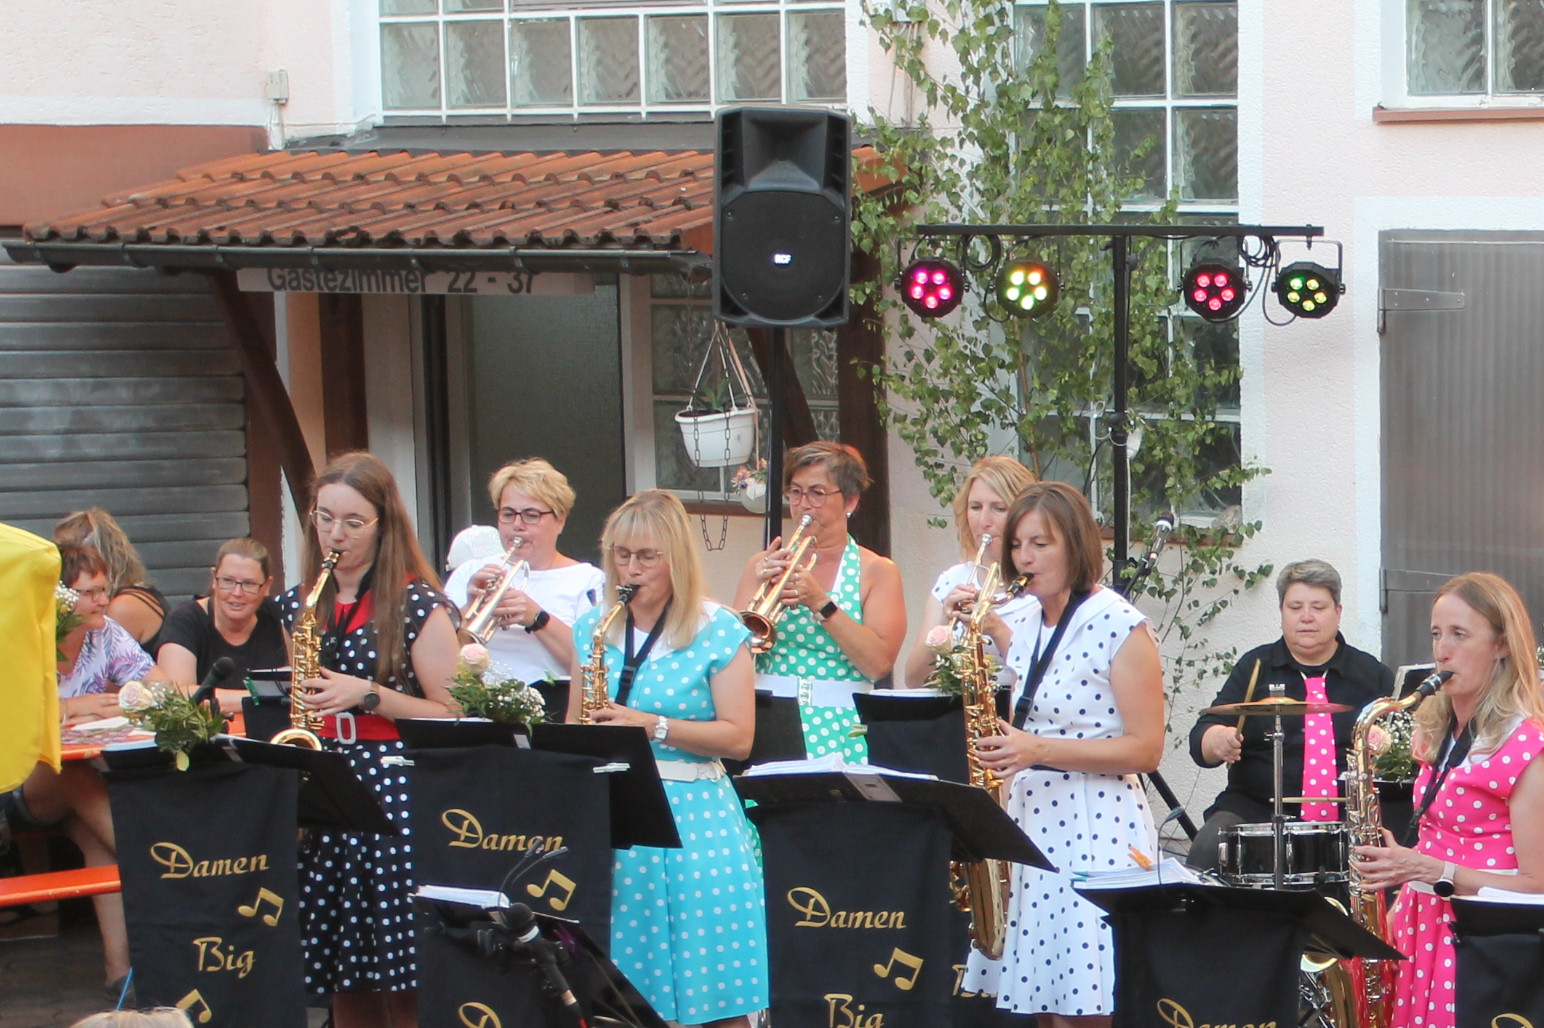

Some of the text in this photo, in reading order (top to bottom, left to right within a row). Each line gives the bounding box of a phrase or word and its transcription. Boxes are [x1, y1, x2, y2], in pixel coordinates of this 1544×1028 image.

[149, 841, 269, 879] Damen
[786, 886, 906, 929] Damen
[192, 936, 255, 979] Big
